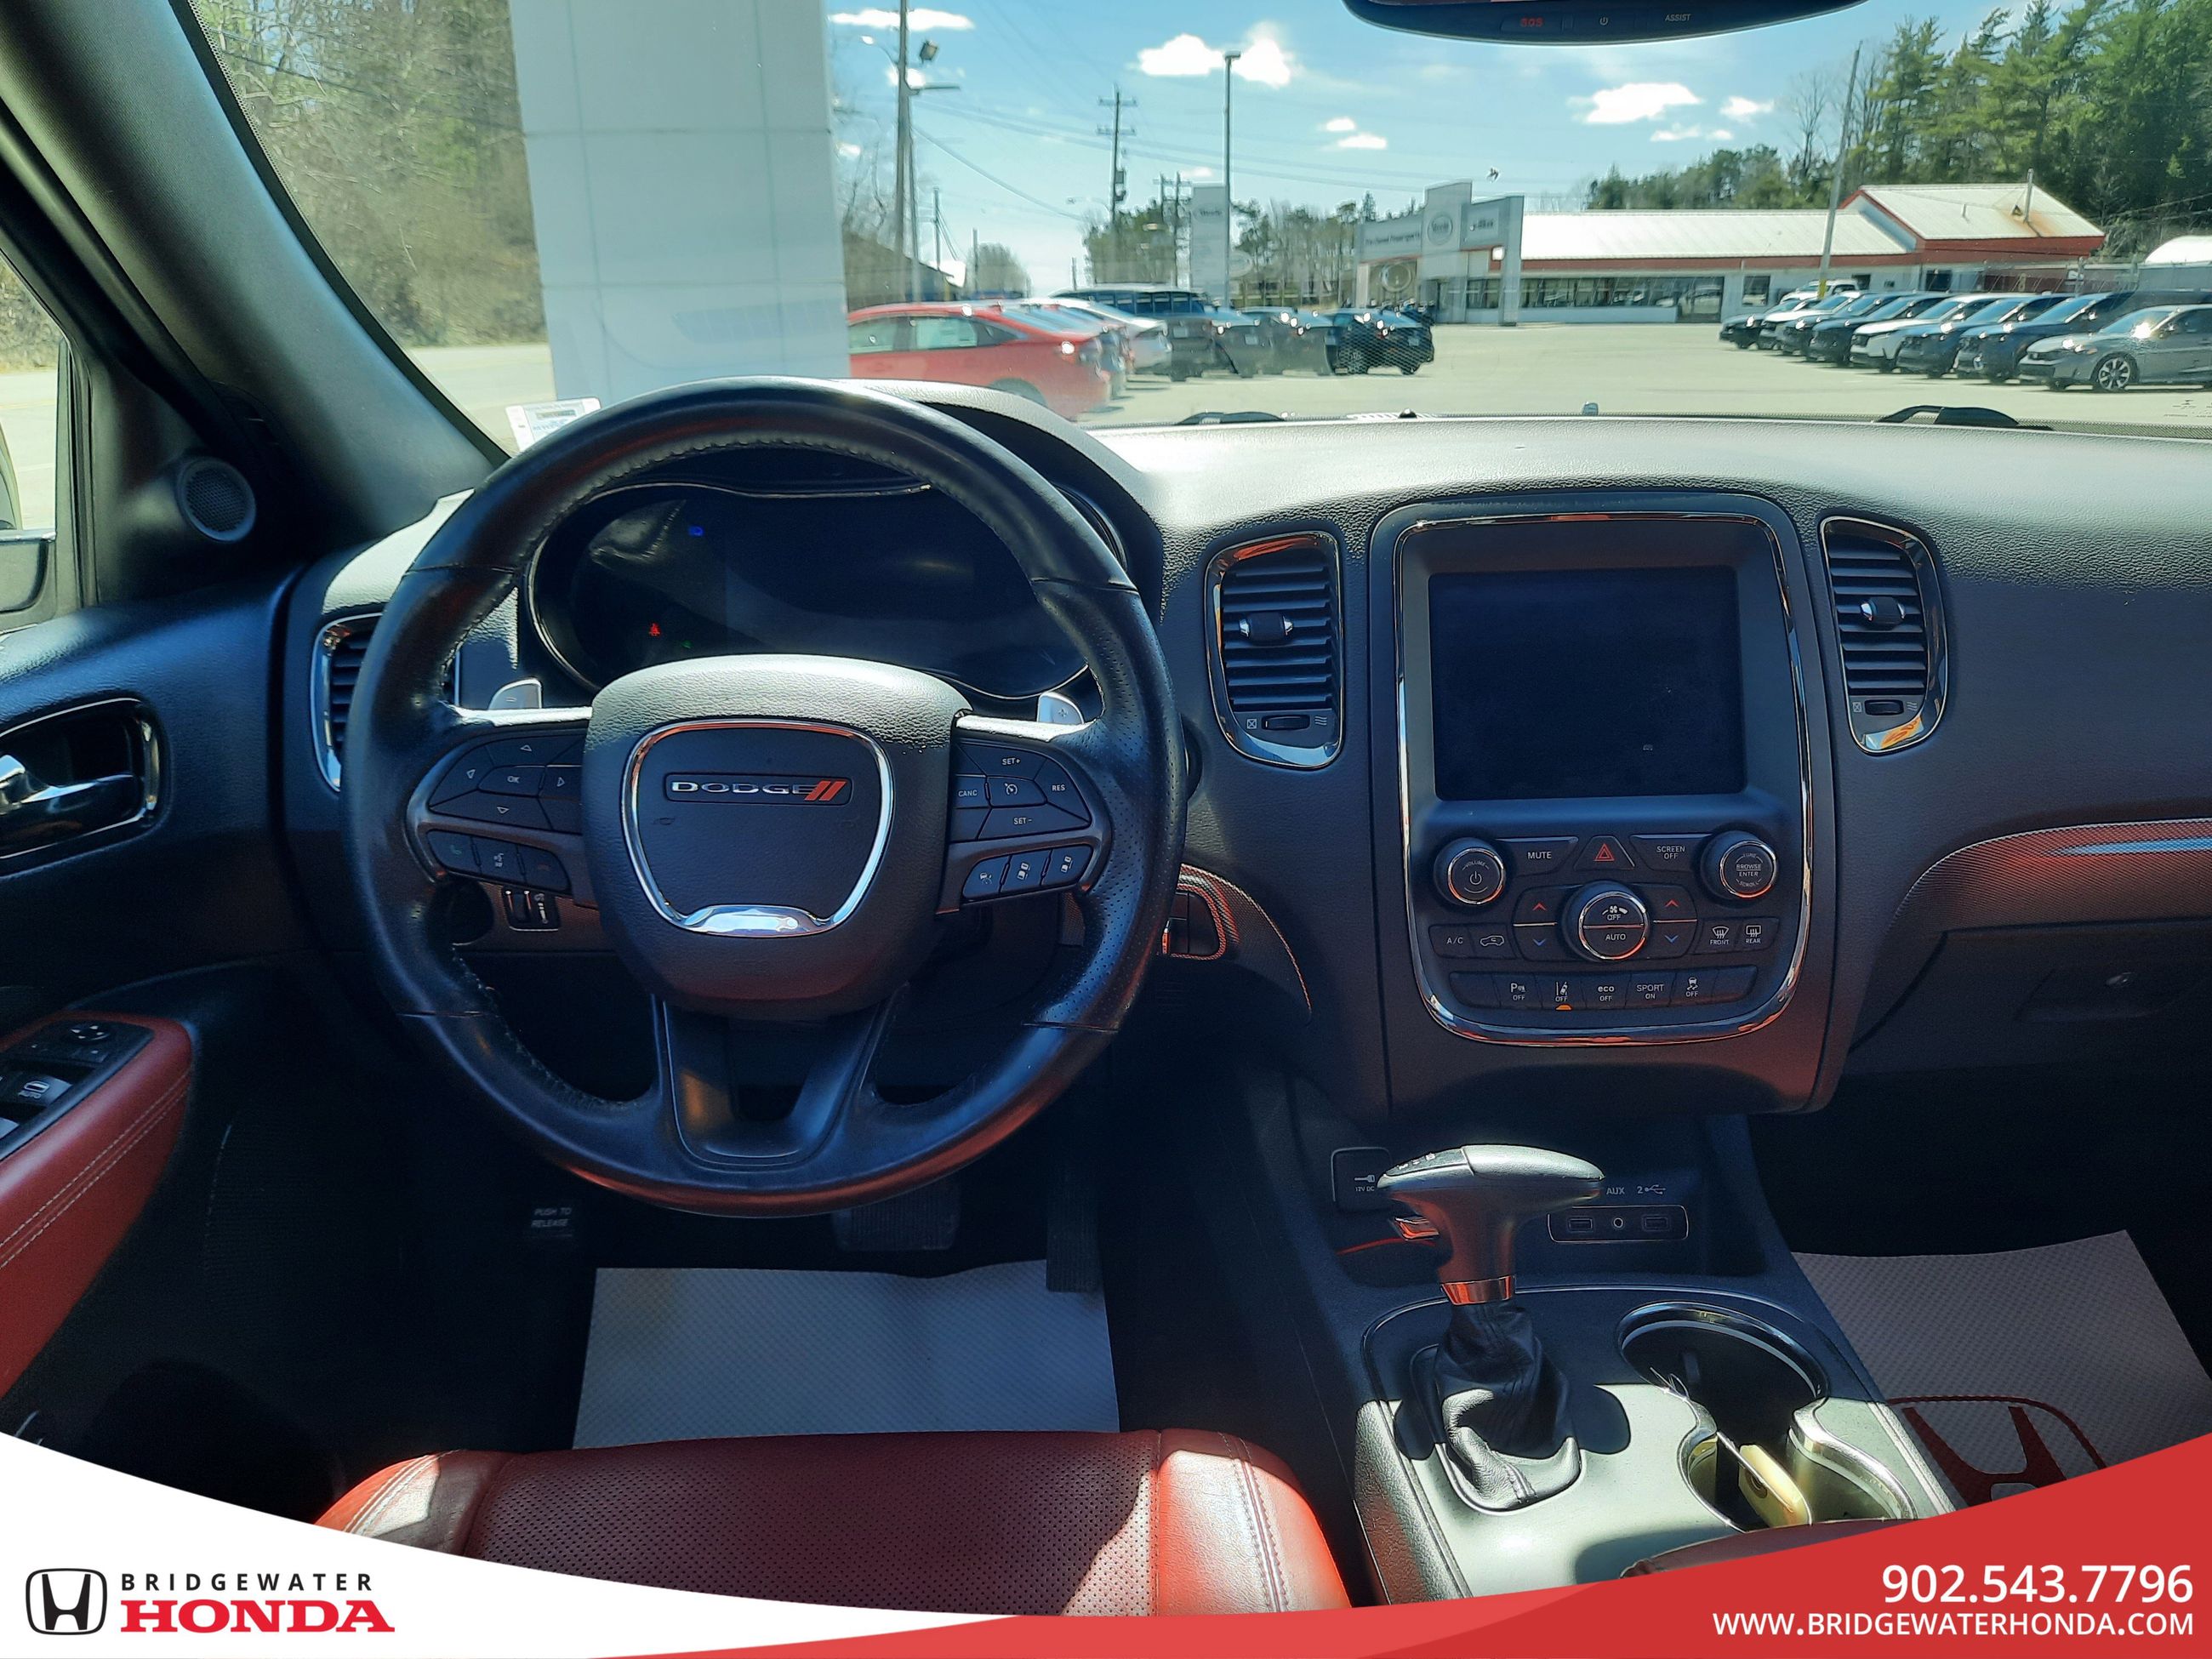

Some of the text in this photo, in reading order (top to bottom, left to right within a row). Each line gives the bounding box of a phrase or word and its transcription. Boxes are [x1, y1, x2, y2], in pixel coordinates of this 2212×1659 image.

[1519, 17, 1543, 27] SOS
[1665, 13, 1691, 22] ASSIST
[507, 775, 520, 784] OK
[672, 781, 818, 795] DODGE
[1052, 784, 1065, 792] RES
[958, 790, 978, 798] CANC
[1527, 851, 1552, 860] MUTE
[1636, 983, 1665, 992] SPORT
[1606, 1187, 1625, 1195] AUX
[1637, 1186, 1644, 1194] 2
